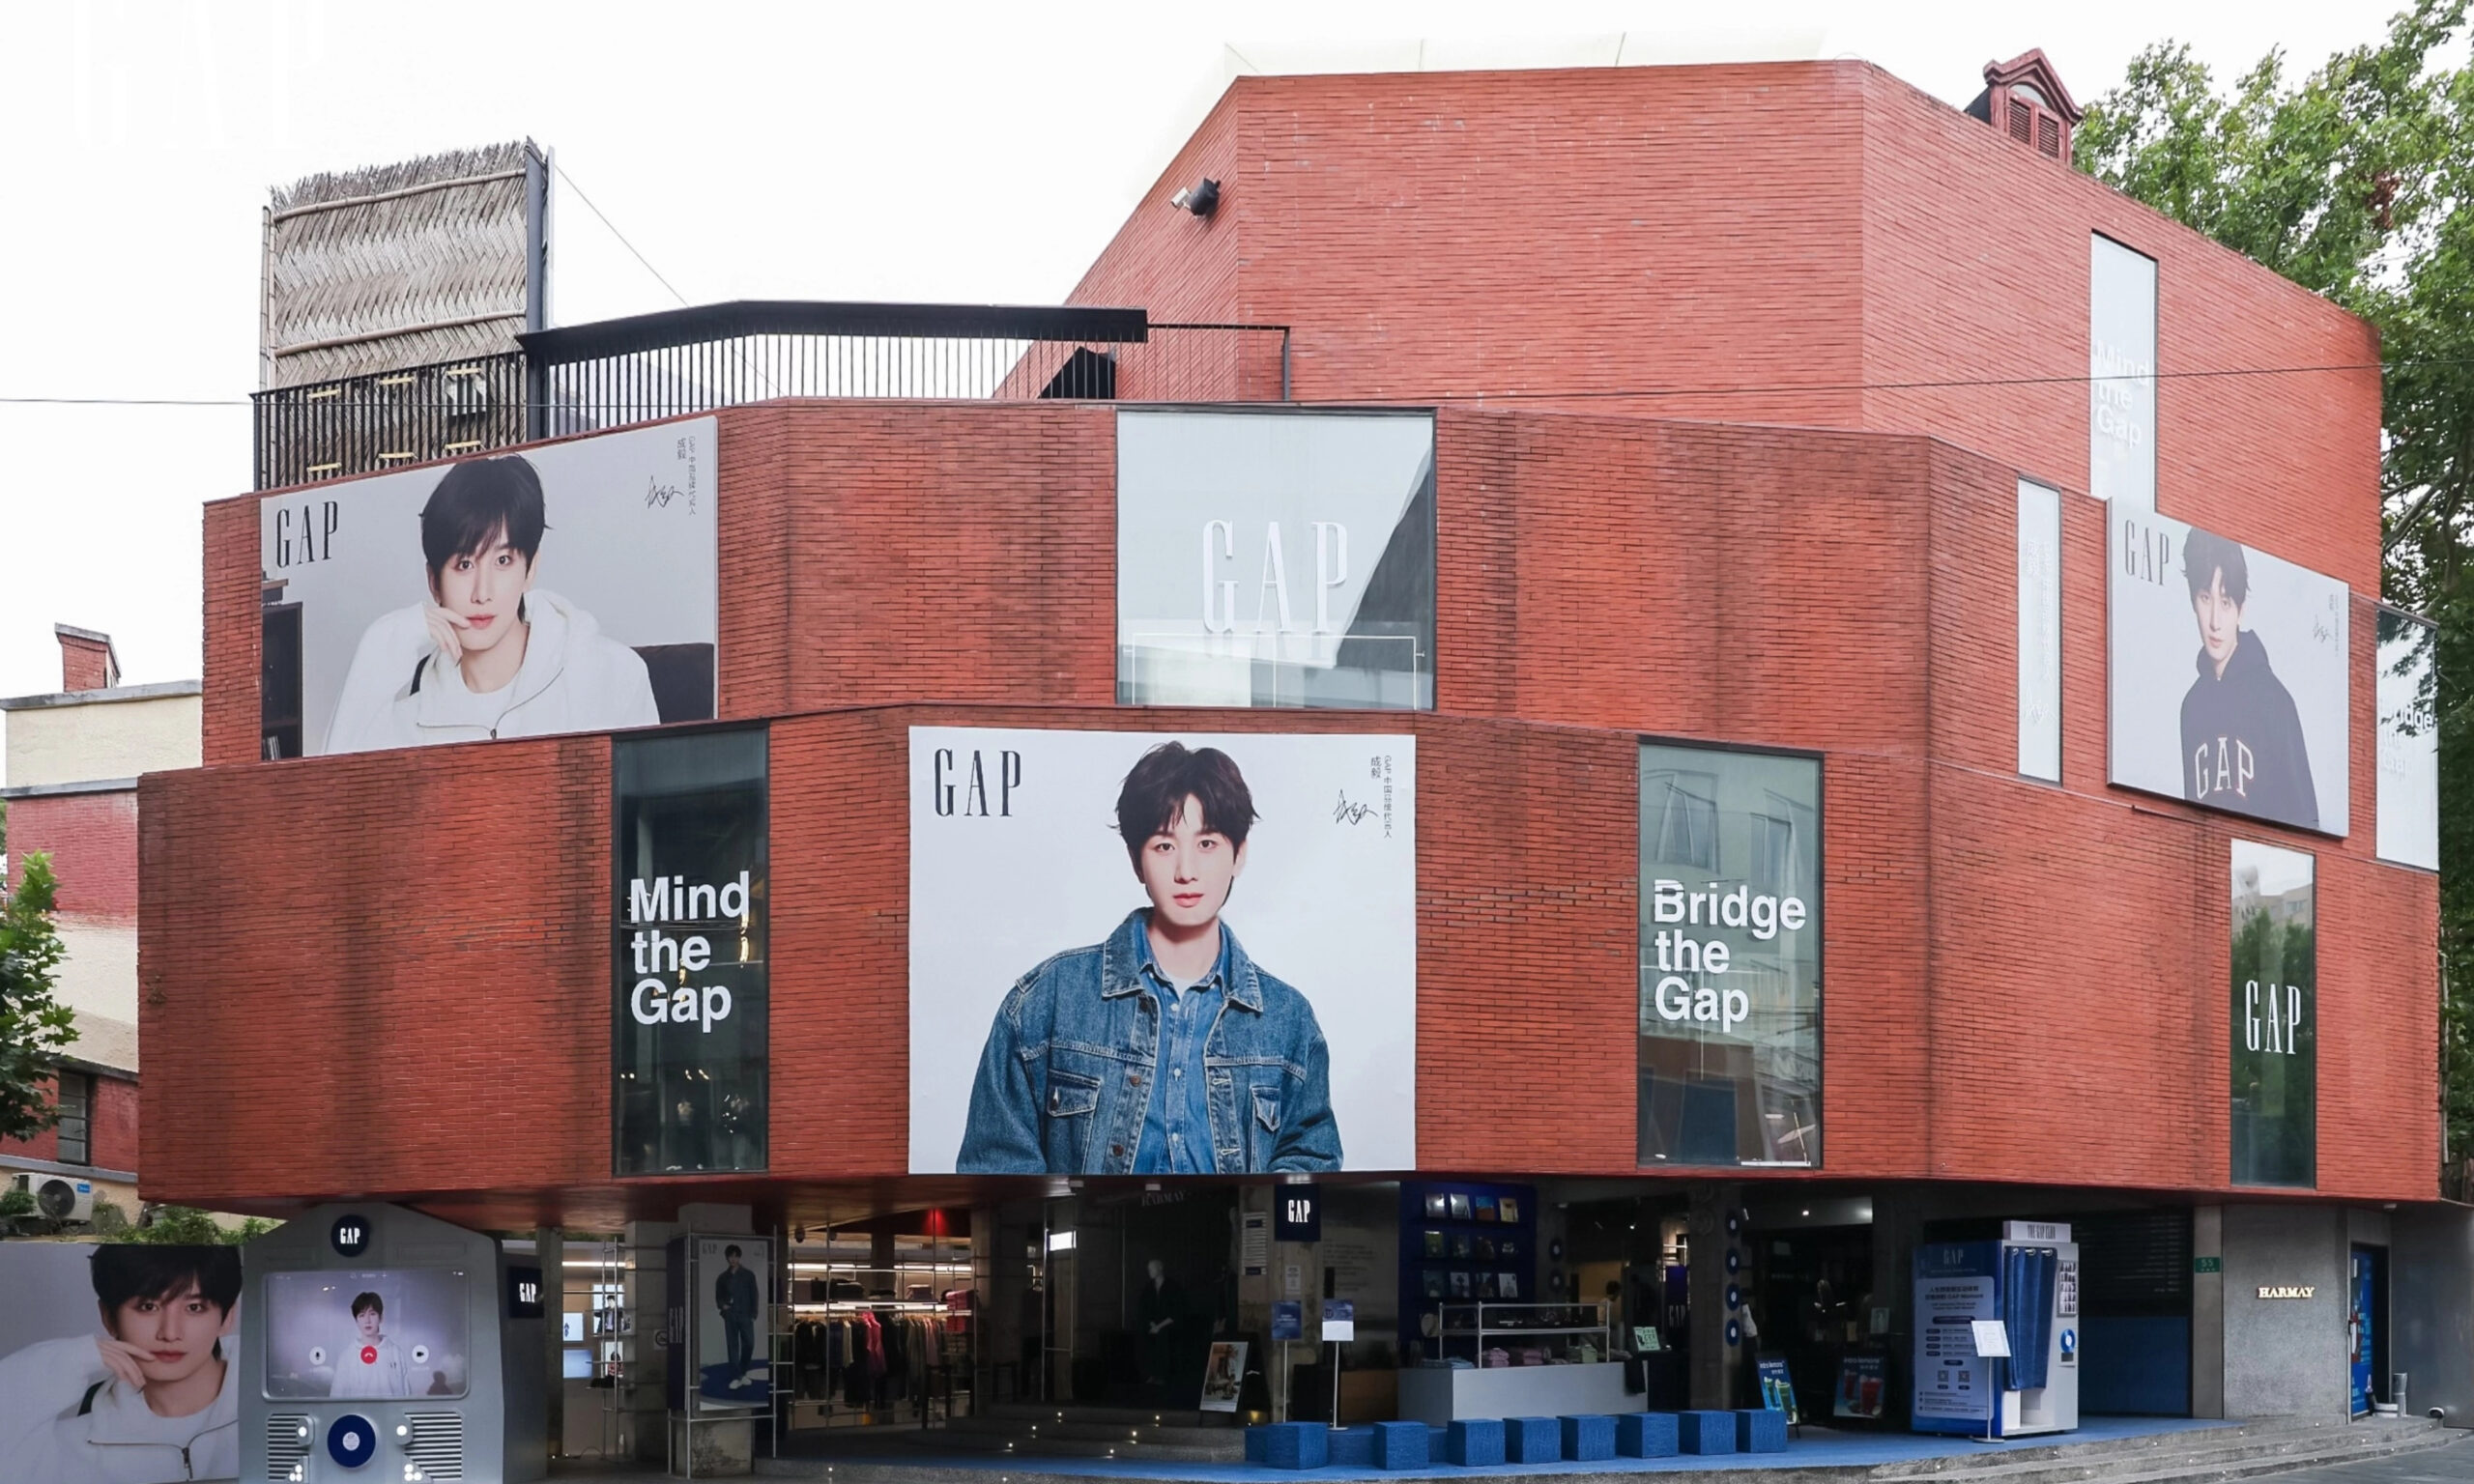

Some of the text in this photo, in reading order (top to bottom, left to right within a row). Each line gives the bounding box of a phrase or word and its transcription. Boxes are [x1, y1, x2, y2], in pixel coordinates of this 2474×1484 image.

[2096, 404, 2143, 449] Gap
[276, 500, 338, 569] GAP
[2124, 519, 2171, 586] GAP
[1203, 519, 1348, 635] GAP
[935, 748, 1021, 817] GAP
[2194, 735, 2255, 801] GAP
[630, 870, 749, 923] Mind
[1654, 879, 1806, 940] Bridge
[631, 929, 711, 975] the
[1654, 929, 1731, 974] the
[631, 978, 732, 1034] Gap
[1654, 976, 1749, 1033] Gap
[2245, 980, 2302, 1055] GAP
[340, 1227, 360, 1244] GAP
[1287, 1199, 1310, 1223] GAP
[1943, 1248, 1964, 1265] GAP
[519, 1282, 536, 1303] GAP
[2258, 1286, 2316, 1298] HARMAY
[669, 1305, 684, 1344] GAP
